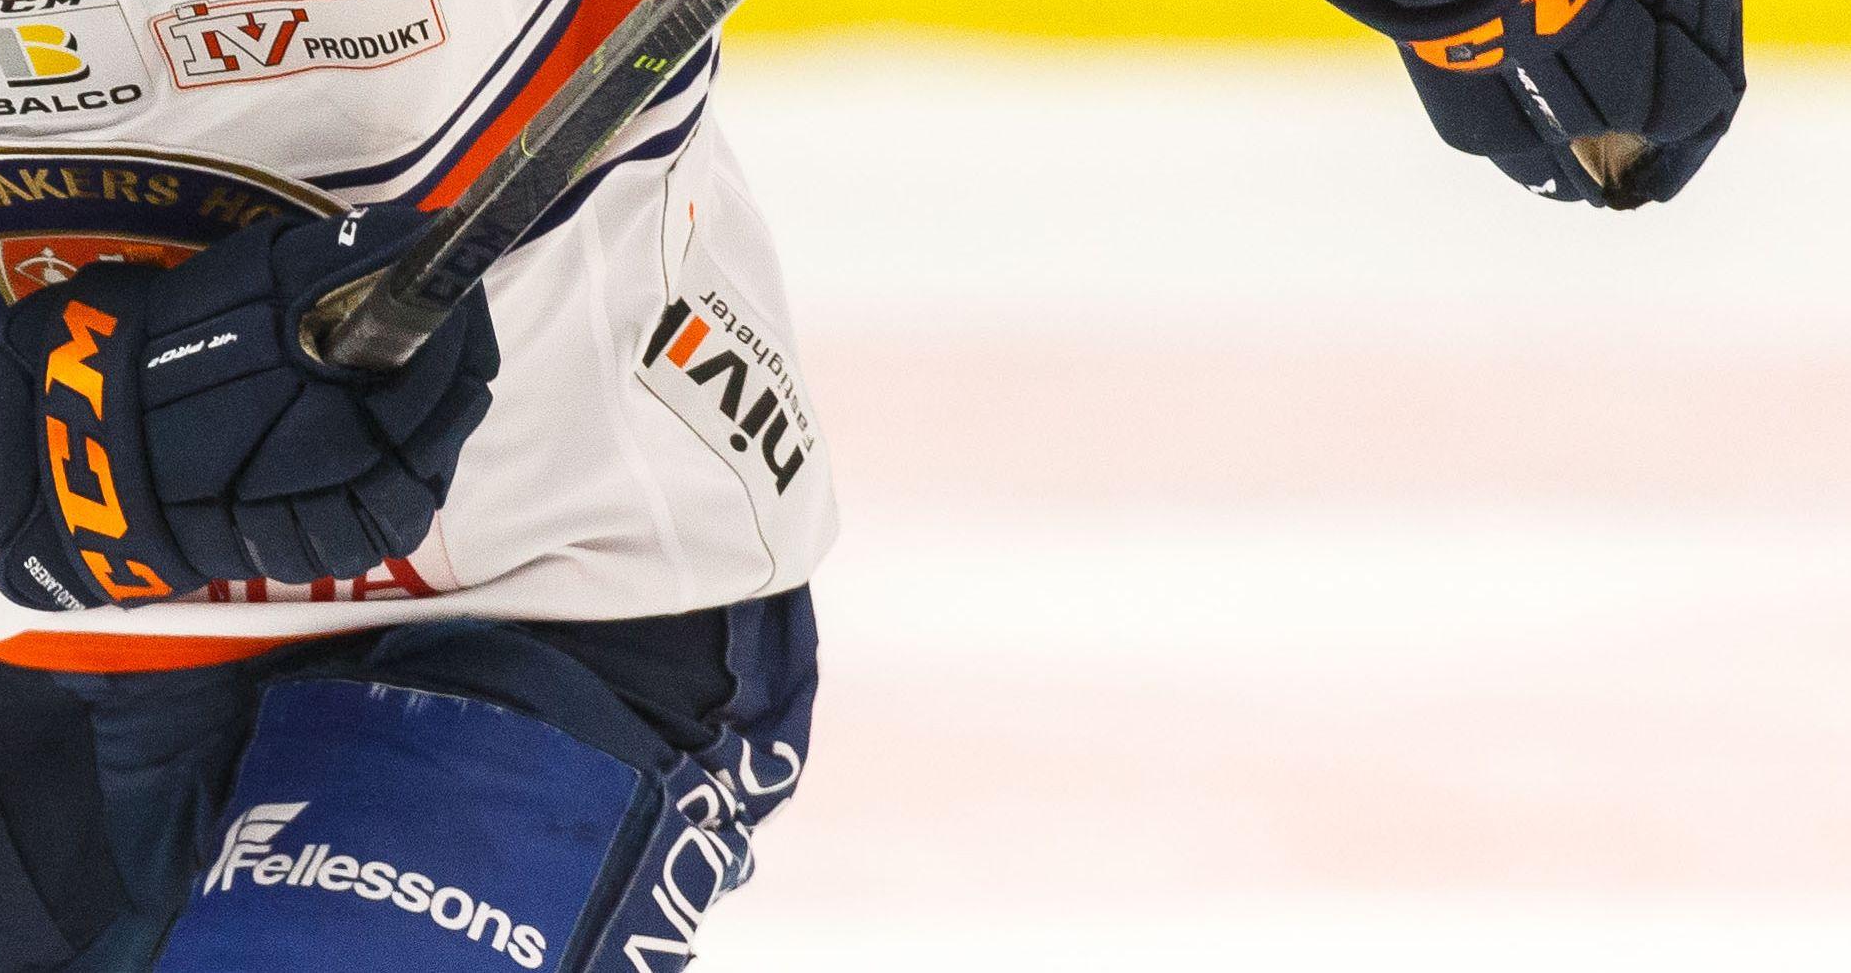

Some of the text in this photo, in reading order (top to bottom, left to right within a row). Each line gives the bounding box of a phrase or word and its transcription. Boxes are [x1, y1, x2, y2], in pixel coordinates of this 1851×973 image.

[303, 19, 431, 61] PRODUKT
[45, 300, 172, 603] CCM
[205, 801, 547, 969] Fellessons
